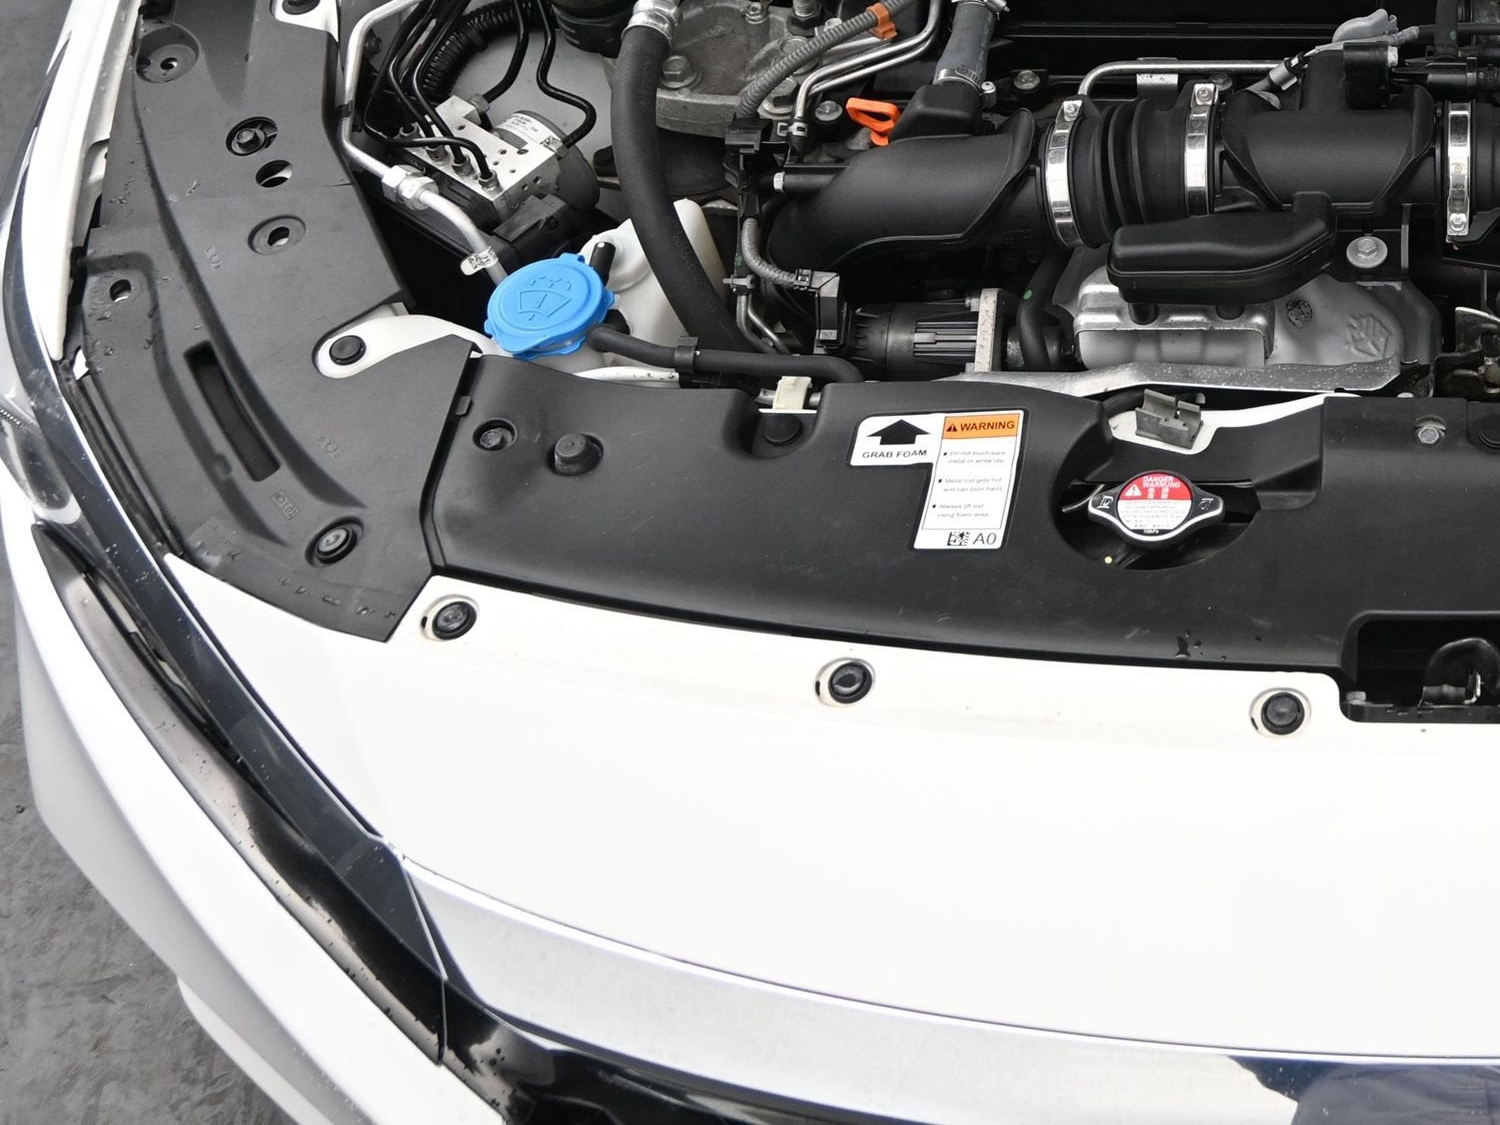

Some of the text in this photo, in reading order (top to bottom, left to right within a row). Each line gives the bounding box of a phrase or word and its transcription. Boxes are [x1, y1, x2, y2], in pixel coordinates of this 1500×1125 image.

[960, 420, 1015, 433] WARNING
[862, 449, 928, 460] GRAB FOAM
[972, 532, 998, 547] A0
